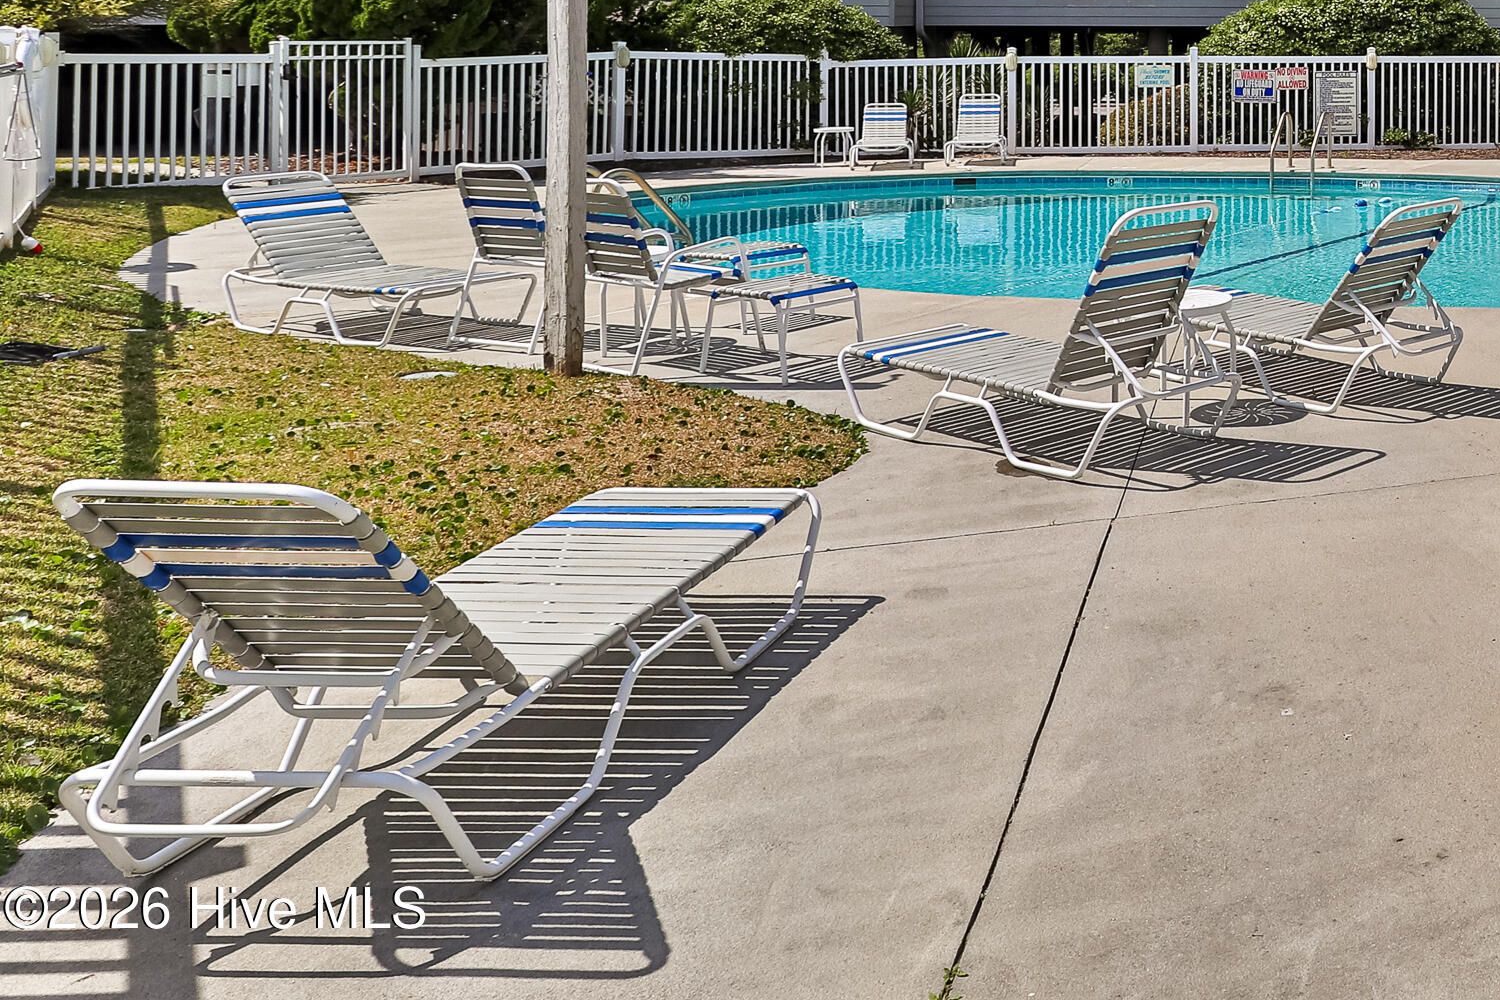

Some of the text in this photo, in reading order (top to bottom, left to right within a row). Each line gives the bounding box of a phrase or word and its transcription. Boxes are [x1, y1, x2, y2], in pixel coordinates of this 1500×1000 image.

[1241, 71, 1268, 80] WARNING
[1277, 67, 1307, 76] NO DIVING
[1244, 79, 1273, 88] LIFEGUARD
[1277, 79, 1307, 89] ALLOWED
